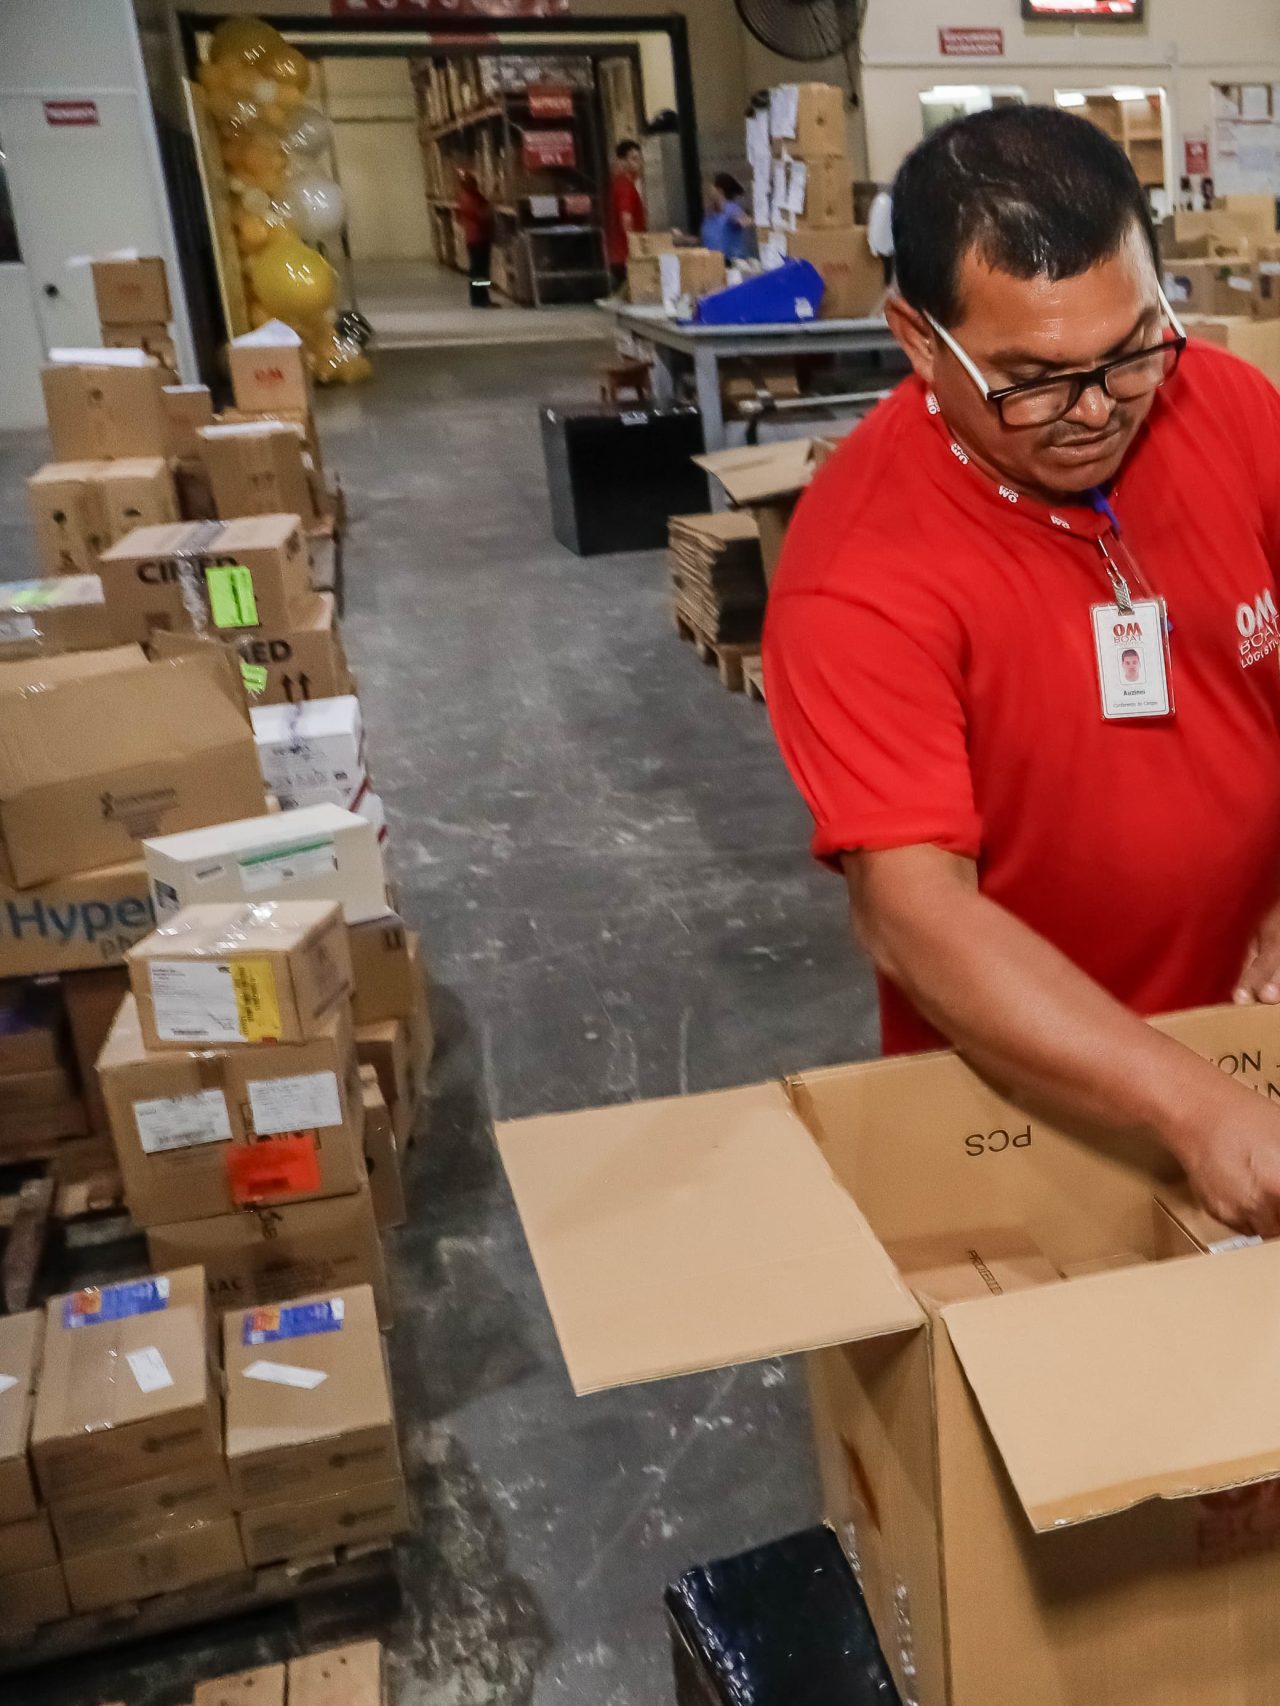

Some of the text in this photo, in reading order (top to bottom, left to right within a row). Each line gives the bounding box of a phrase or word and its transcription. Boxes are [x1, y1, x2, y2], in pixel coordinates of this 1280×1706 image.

[1236, 587, 1278, 638] OM
[1112, 622, 1143, 637] OM
[1113, 635, 1142, 644] BOAT
[1240, 614, 1280, 656] BOAT
[964, 1125, 1031, 1156] PCS
